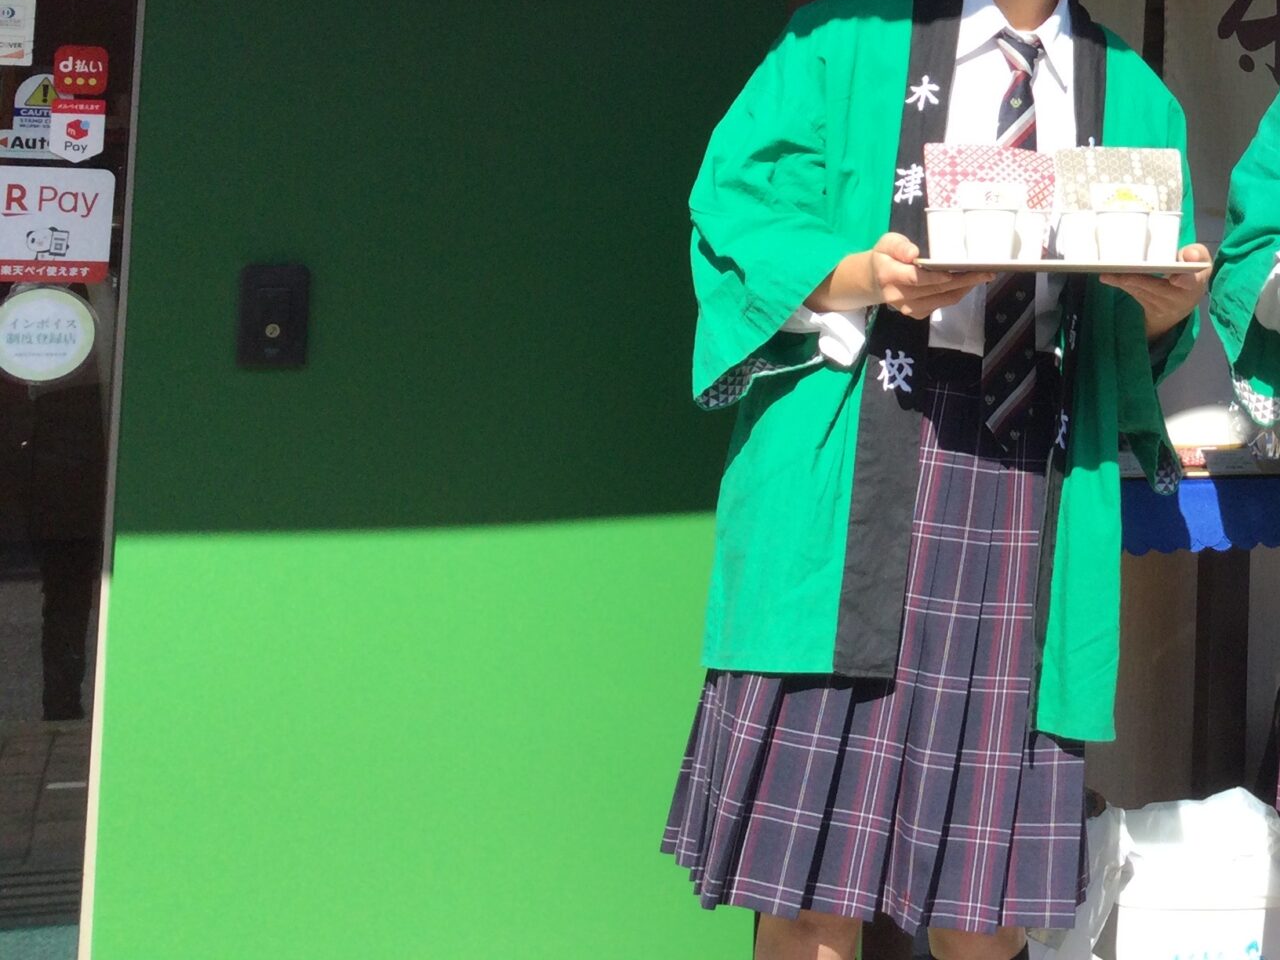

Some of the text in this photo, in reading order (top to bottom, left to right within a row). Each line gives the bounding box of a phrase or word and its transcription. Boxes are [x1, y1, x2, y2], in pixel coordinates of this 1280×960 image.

[59, 55, 103, 74] d払い
[20, 108, 52, 117] CAUT
[10, 136, 50, 150] Aut
[64, 141, 88, 153] Pay
[38, 186, 99, 218] Pay
[0, 265, 90, 277] 楽天ペイ使えます
